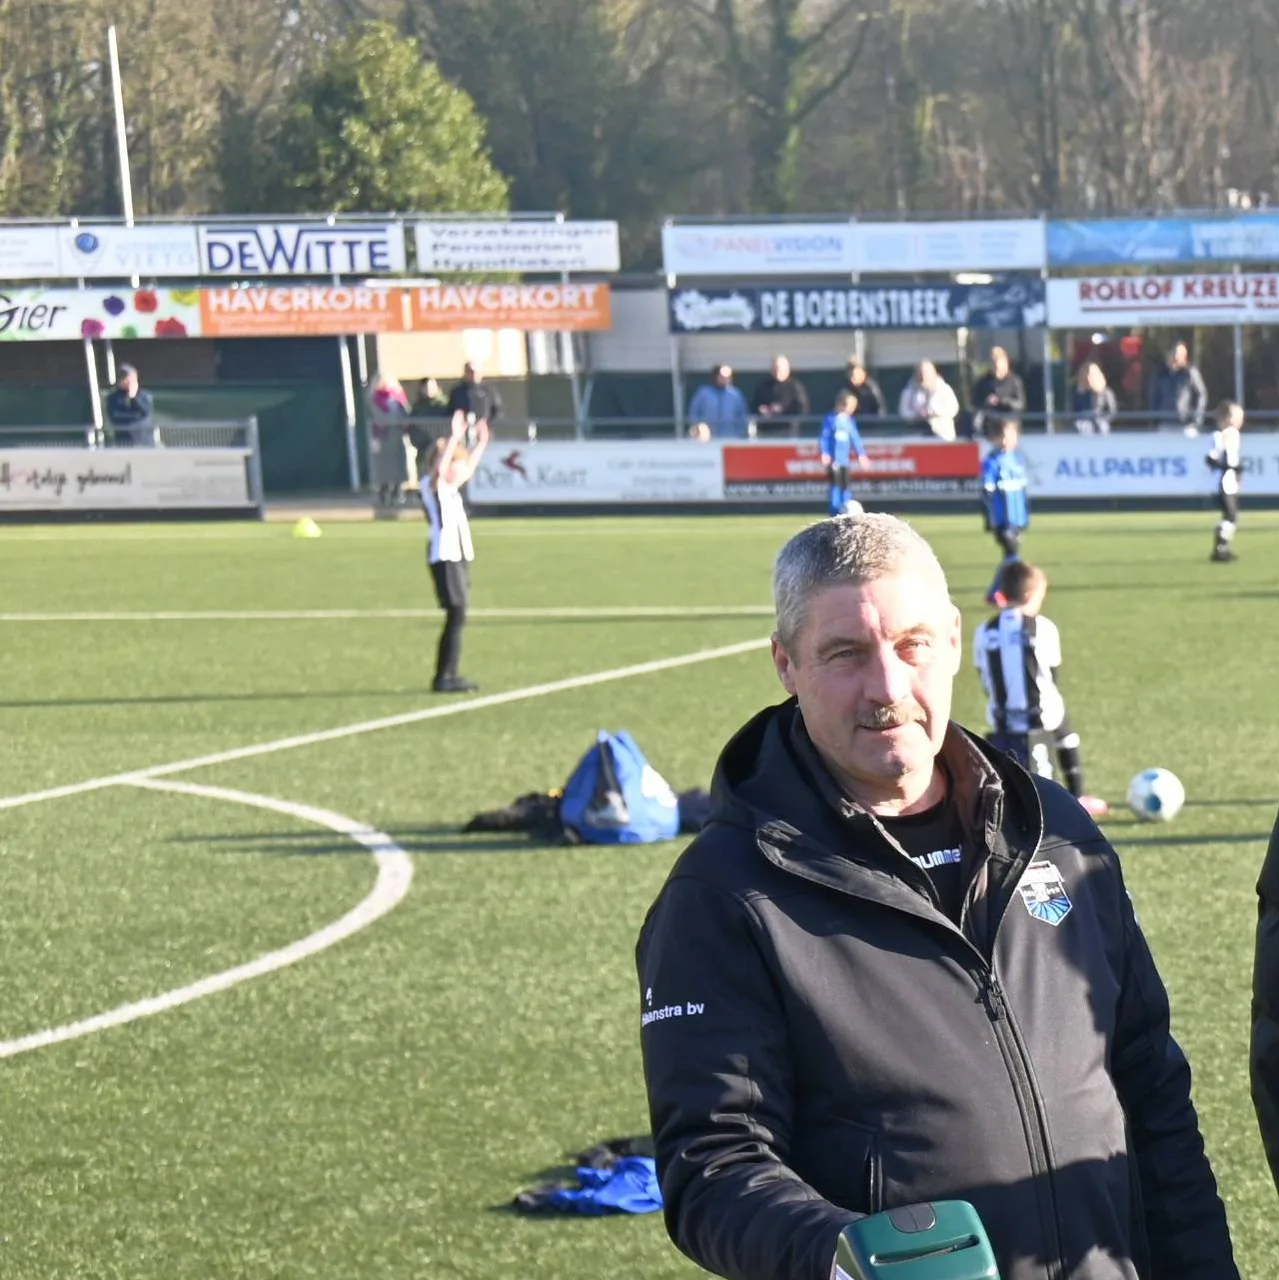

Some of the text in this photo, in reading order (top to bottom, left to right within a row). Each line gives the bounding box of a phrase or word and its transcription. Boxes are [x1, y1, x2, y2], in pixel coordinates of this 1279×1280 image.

[1079, 276, 1279, 301] ROELOF KREUZE
[761, 291, 789, 327] DE
[1055, 454, 1188, 478] ALLPARTS
[687, 1002, 704, 1015] bv
